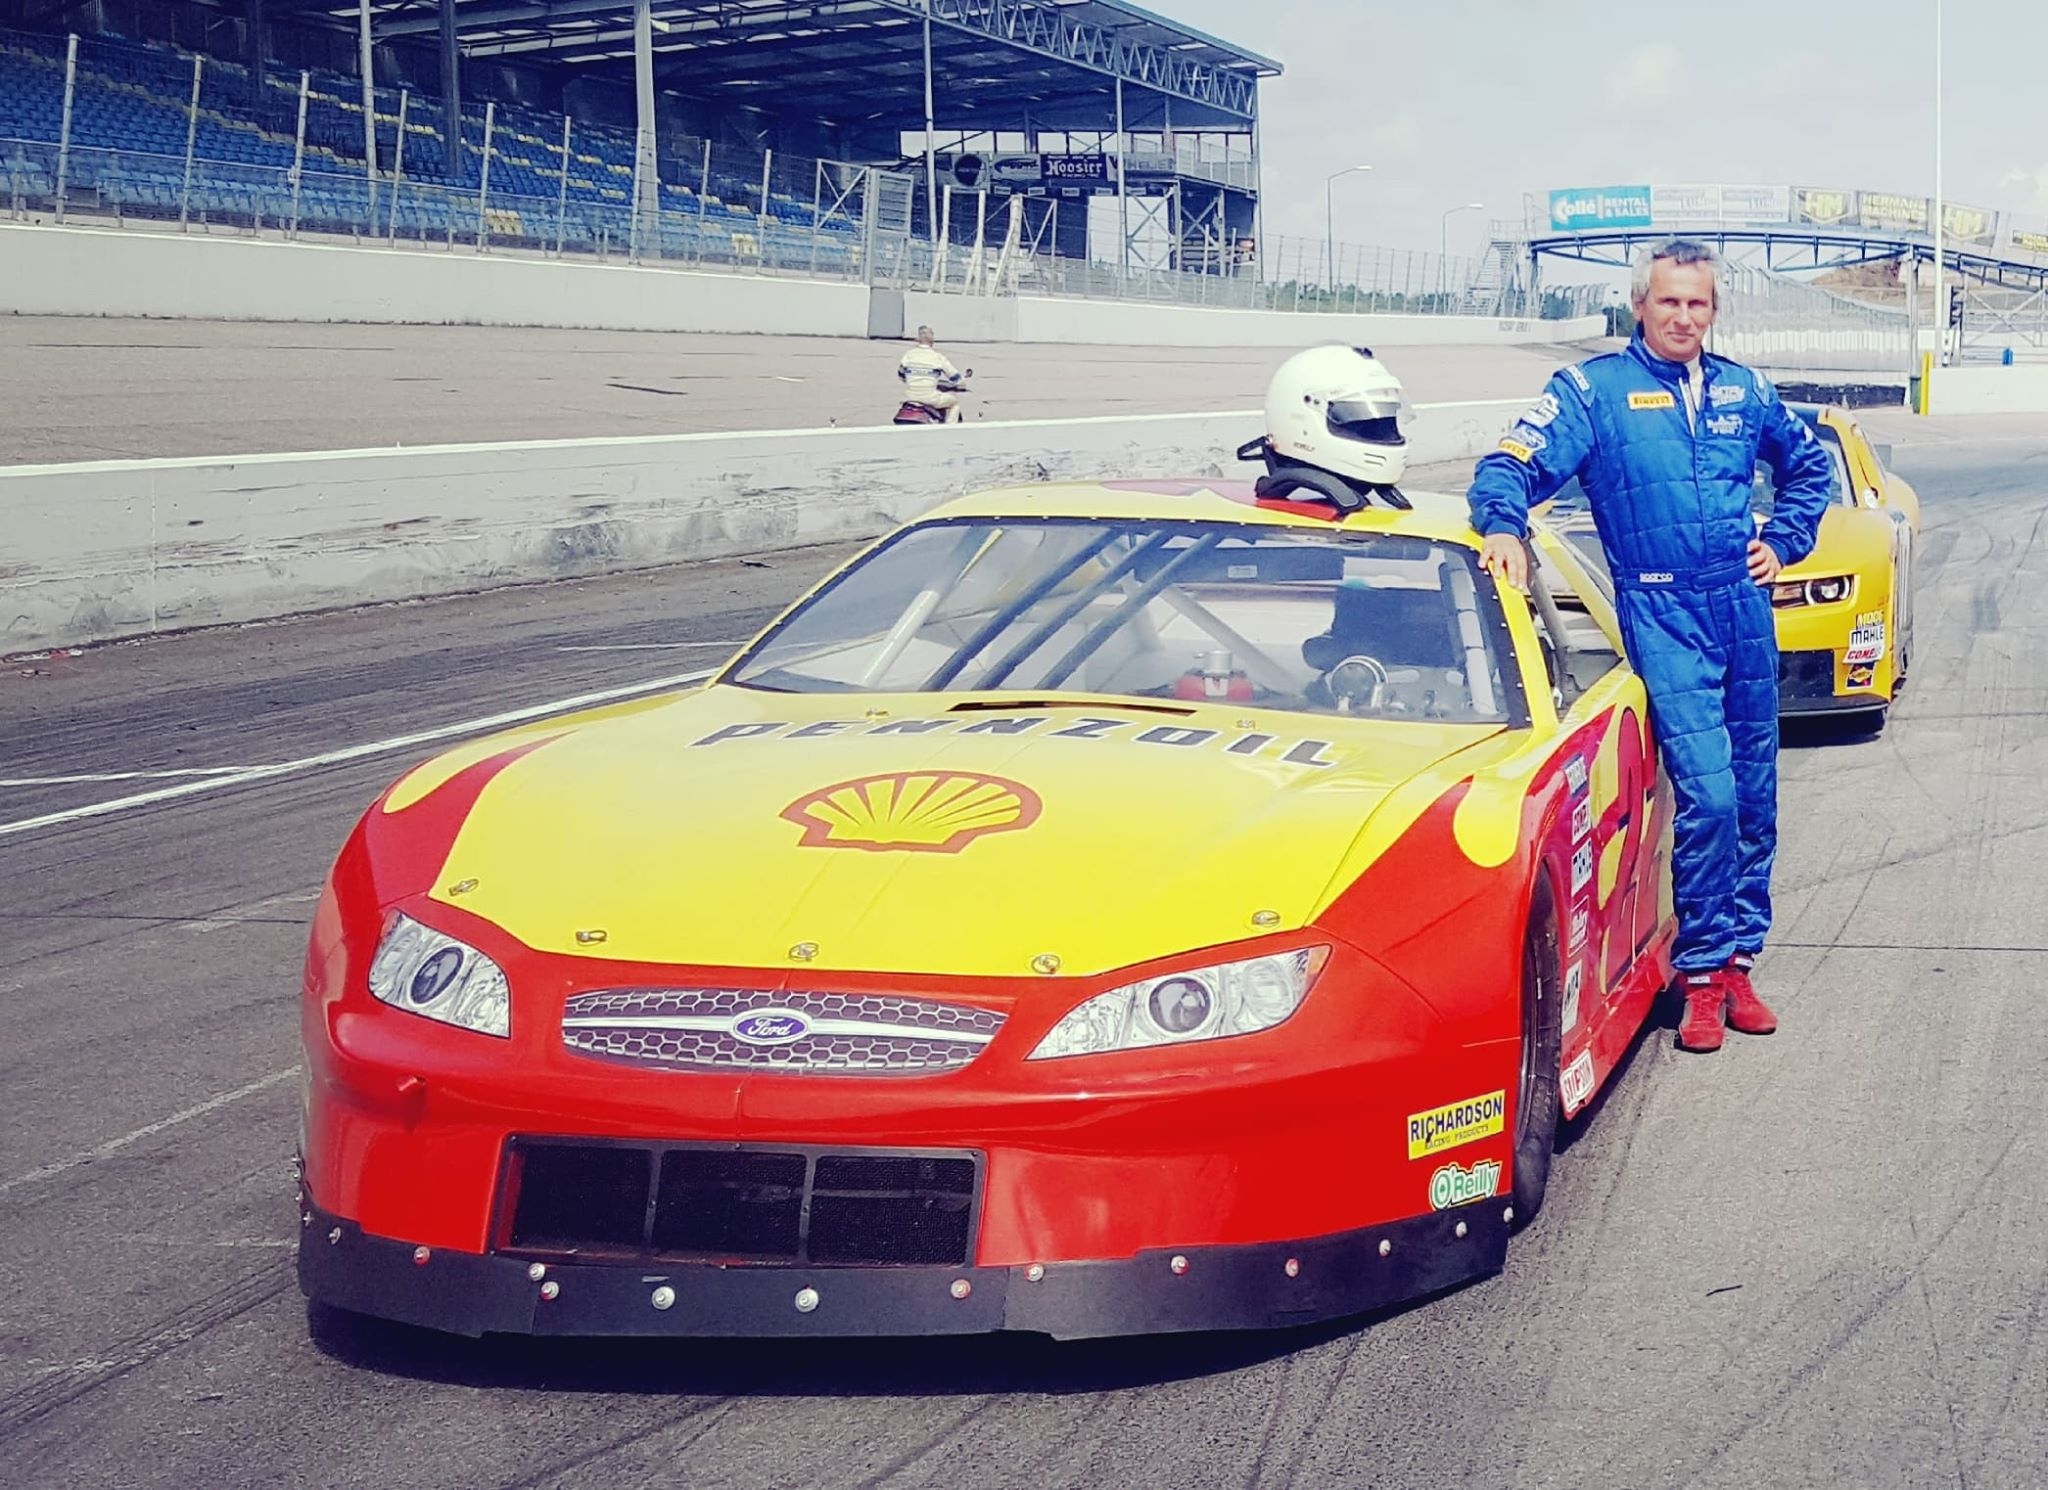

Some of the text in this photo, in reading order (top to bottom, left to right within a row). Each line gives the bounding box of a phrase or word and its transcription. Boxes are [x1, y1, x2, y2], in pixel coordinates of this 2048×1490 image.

[1851, 625, 1884, 645] MAHLE
[688, 717, 1338, 767] PENNZOIL
[747, 1016, 796, 1036] Ford
[1411, 1095, 1503, 1142] RICHARDSON
[1433, 1167, 1498, 1206] O'Reilly
